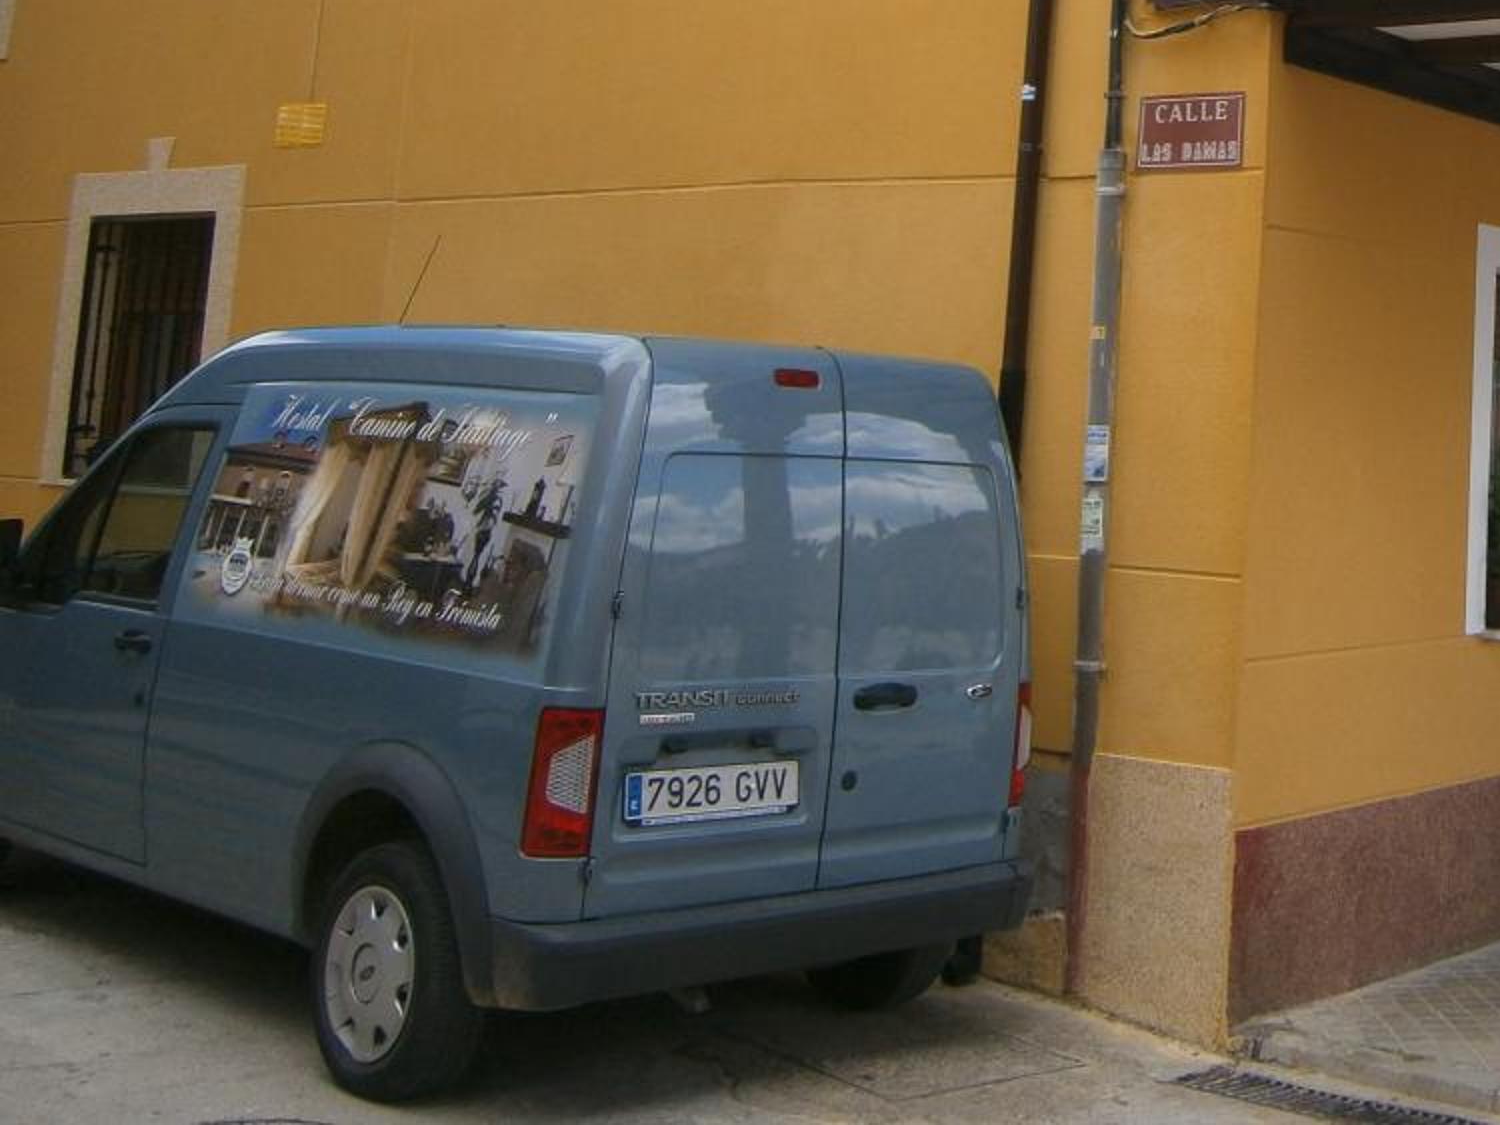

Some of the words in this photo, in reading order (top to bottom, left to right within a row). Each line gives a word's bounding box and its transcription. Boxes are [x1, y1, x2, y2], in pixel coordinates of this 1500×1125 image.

[1155, 100, 1229, 124] CALLE
[1142, 142, 1172, 162] LAS
[1181, 140, 1238, 161] DAMAS
[637, 689, 728, 709] TRANSIT
[647, 774, 721, 812] 7926
[735, 768, 787, 803] GVV
